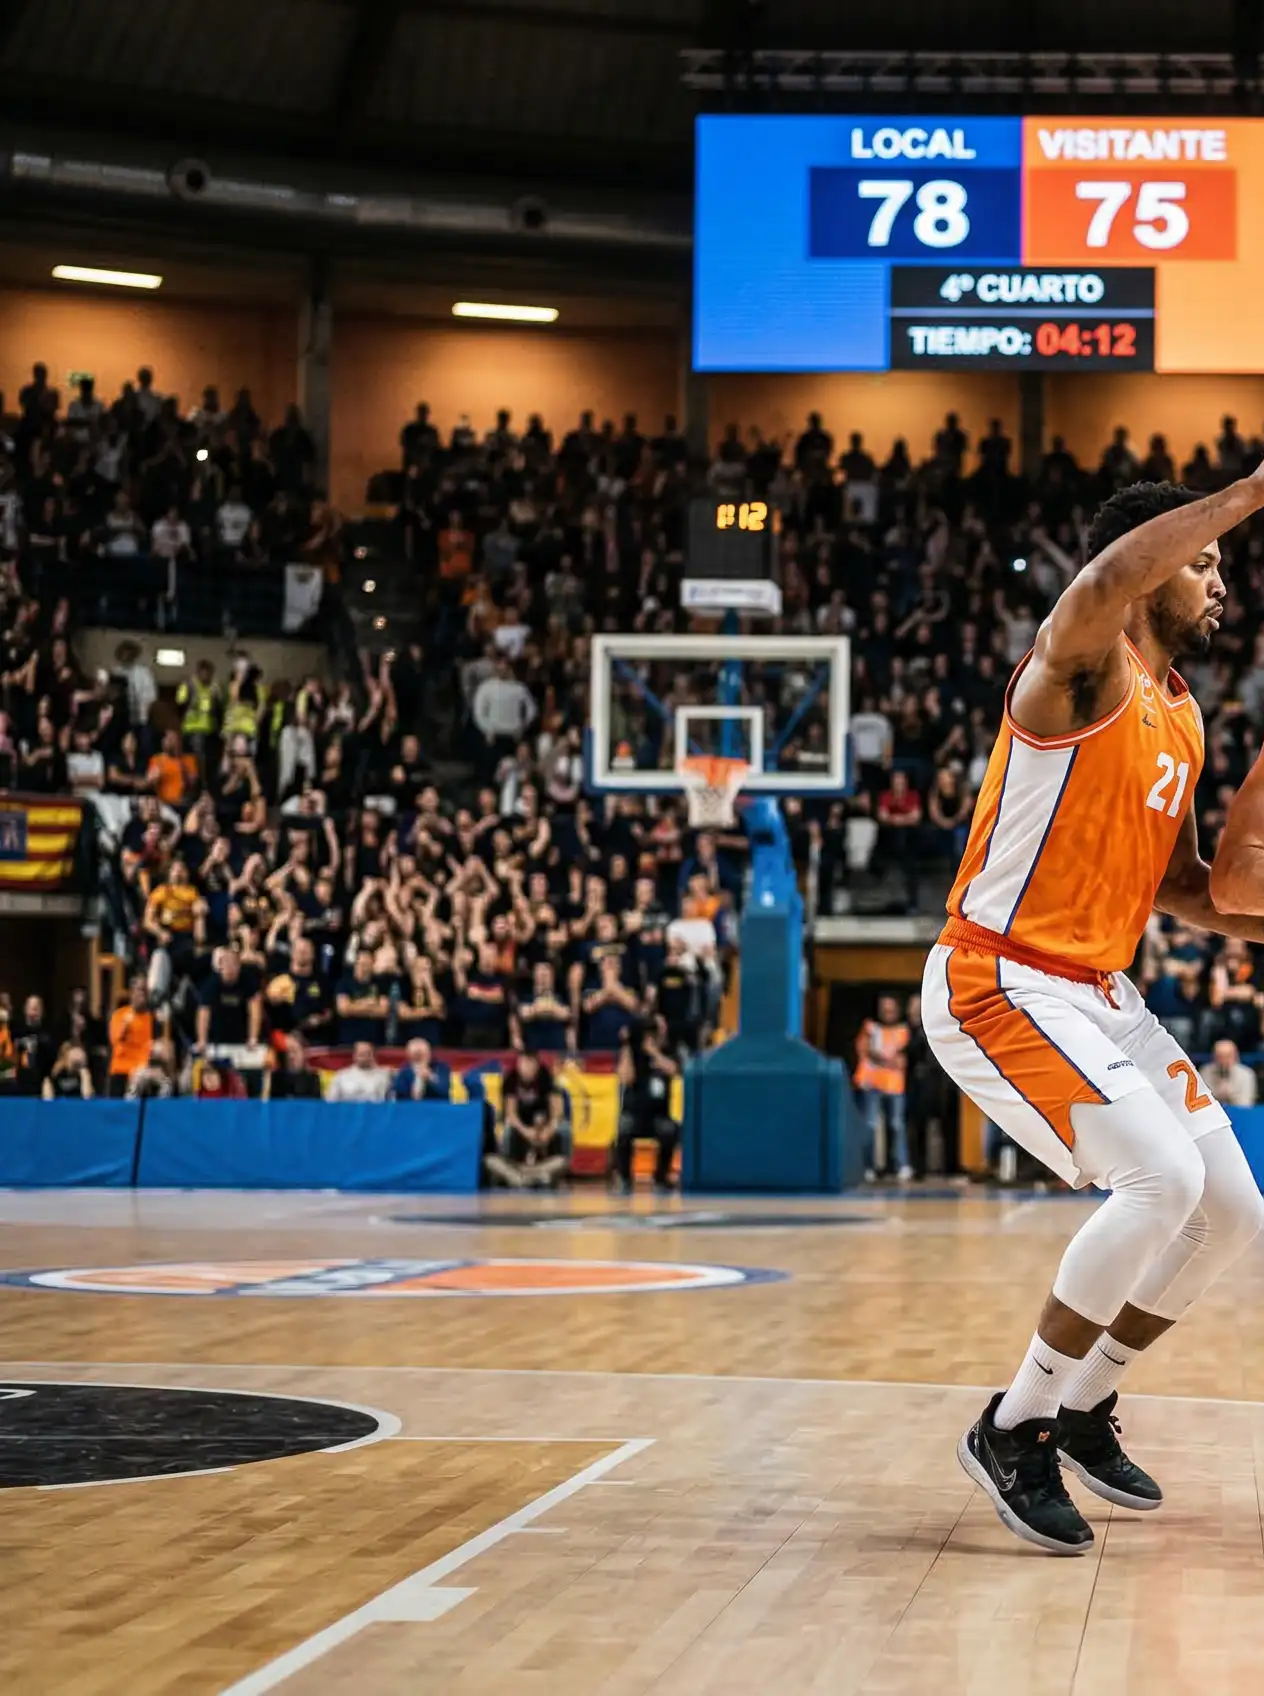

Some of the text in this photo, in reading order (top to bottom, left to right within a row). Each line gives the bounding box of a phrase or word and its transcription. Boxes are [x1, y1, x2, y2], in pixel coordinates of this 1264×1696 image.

[851, 128, 976, 160] LOCAL
[1037, 128, 1228, 162] VISITANTE
[857, 179, 970, 248] 78
[1075, 180, 1190, 250] 75
[976, 273, 1105, 304] CUARTO
[907, 322, 1138, 357] TIEMPO: 04:12
[1145, 751, 1190, 819] 21
